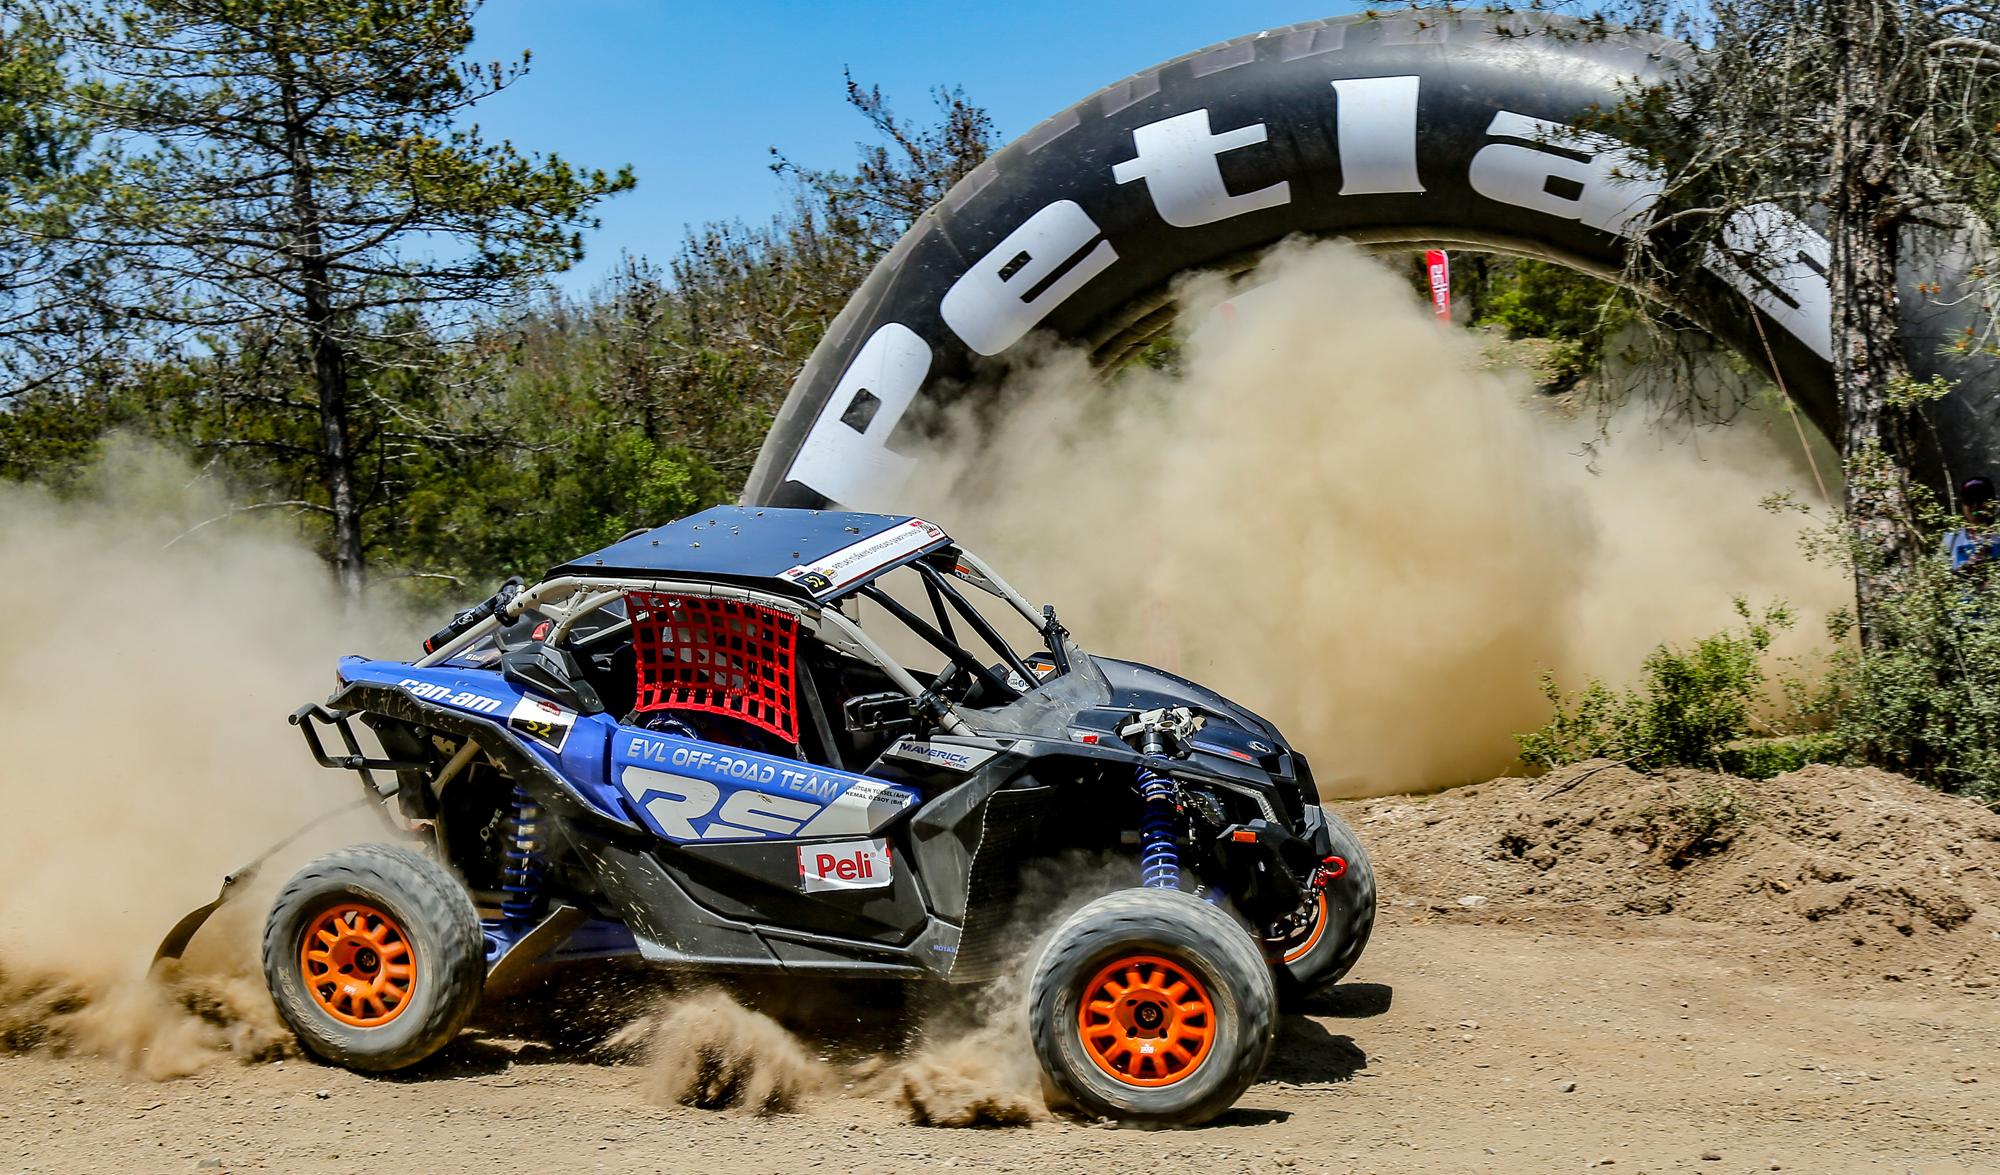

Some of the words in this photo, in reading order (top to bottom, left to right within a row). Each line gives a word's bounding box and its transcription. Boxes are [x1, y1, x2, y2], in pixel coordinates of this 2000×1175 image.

[804, 575, 824, 588] 52
[397, 679, 502, 713] can-am
[526, 720, 551, 738] 52
[899, 743, 970, 764] MAVERICK
[627, 738, 666, 762] EVL
[672, 748, 775, 785] OFF-ROAD
[781, 769, 838, 800] TEAM
[845, 791, 866, 799] KEMAL
[815, 851, 872, 881] Peli
